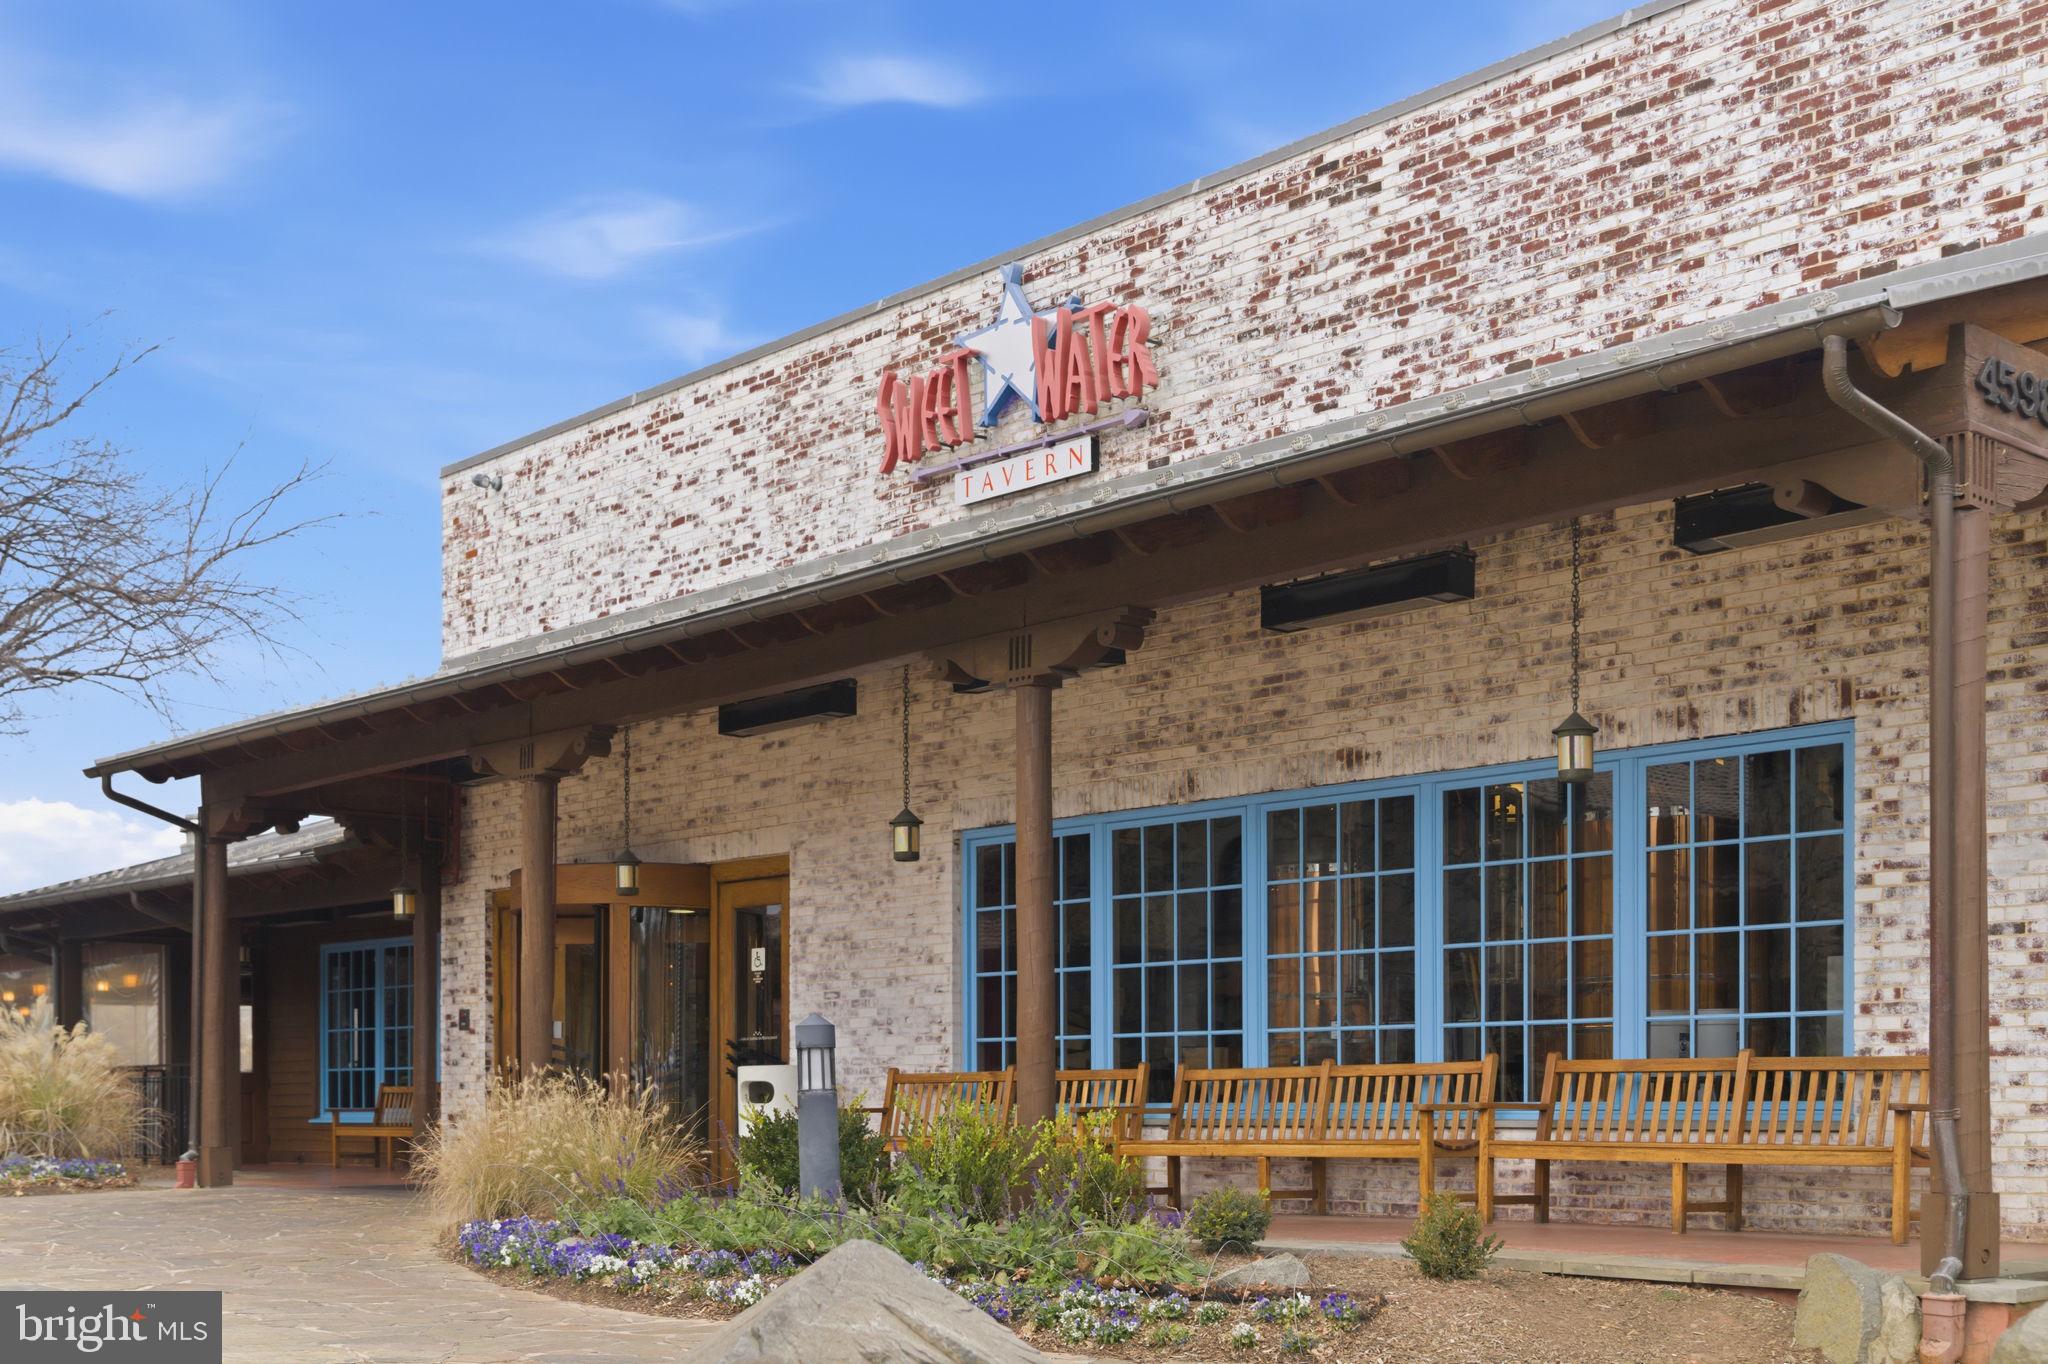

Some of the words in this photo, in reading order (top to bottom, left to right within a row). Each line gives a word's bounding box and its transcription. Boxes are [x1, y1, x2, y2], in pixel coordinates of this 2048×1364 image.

[876, 348, 981, 475] SWEET
[1031, 300, 1159, 423] WATER
[961, 444, 1084, 498] TAVERN
